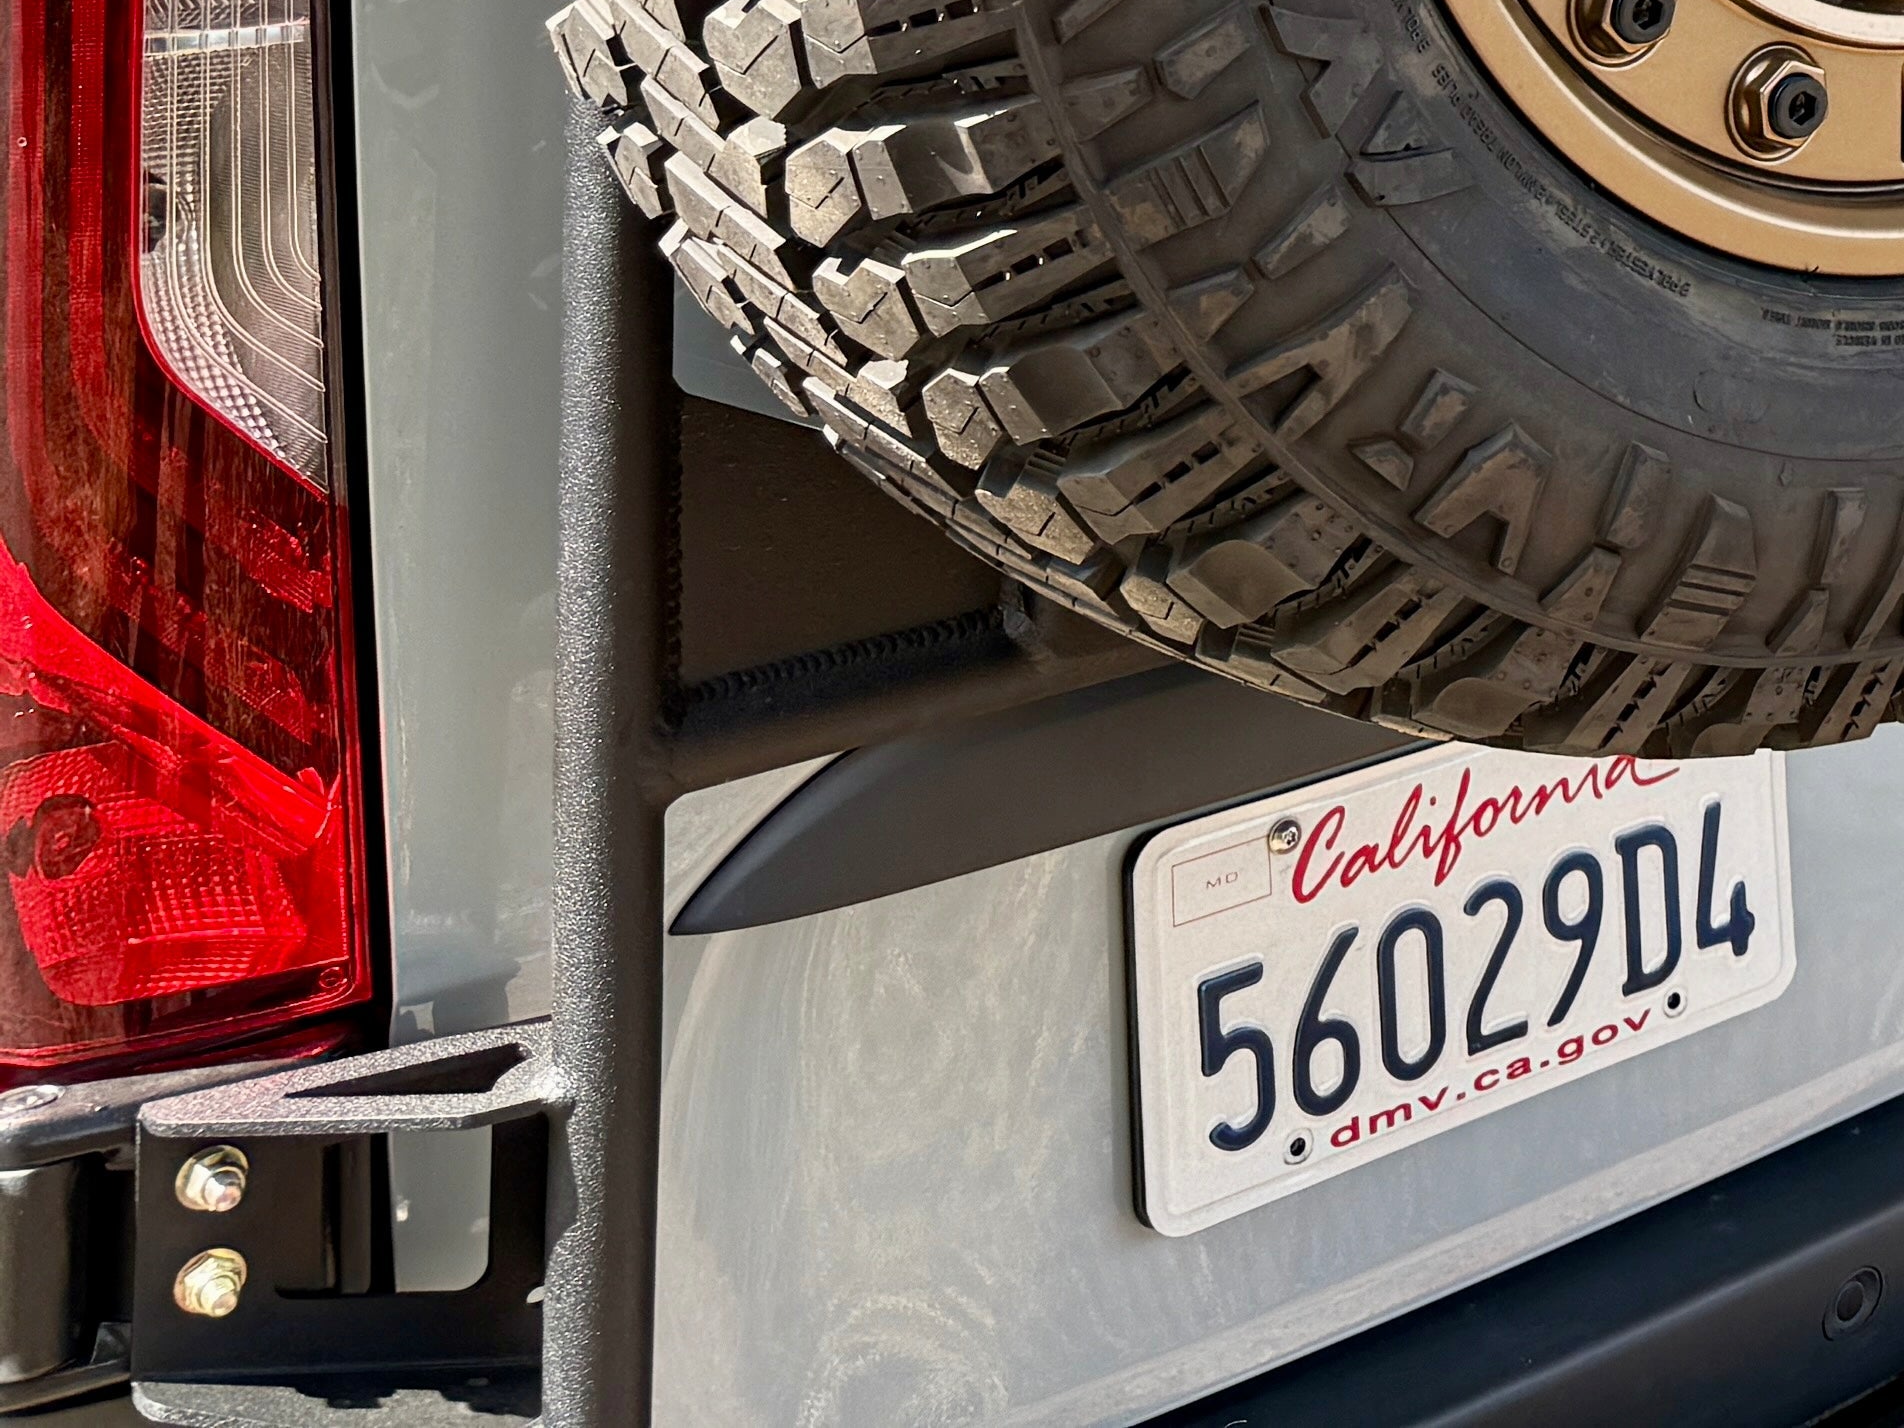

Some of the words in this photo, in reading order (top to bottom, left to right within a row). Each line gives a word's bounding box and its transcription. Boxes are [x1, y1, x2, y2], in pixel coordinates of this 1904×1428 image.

[1290, 754, 1678, 904] California
[1197, 799, 1756, 1153] 56029D4
[1330, 1007, 1652, 1149] dmv.ca.gov
